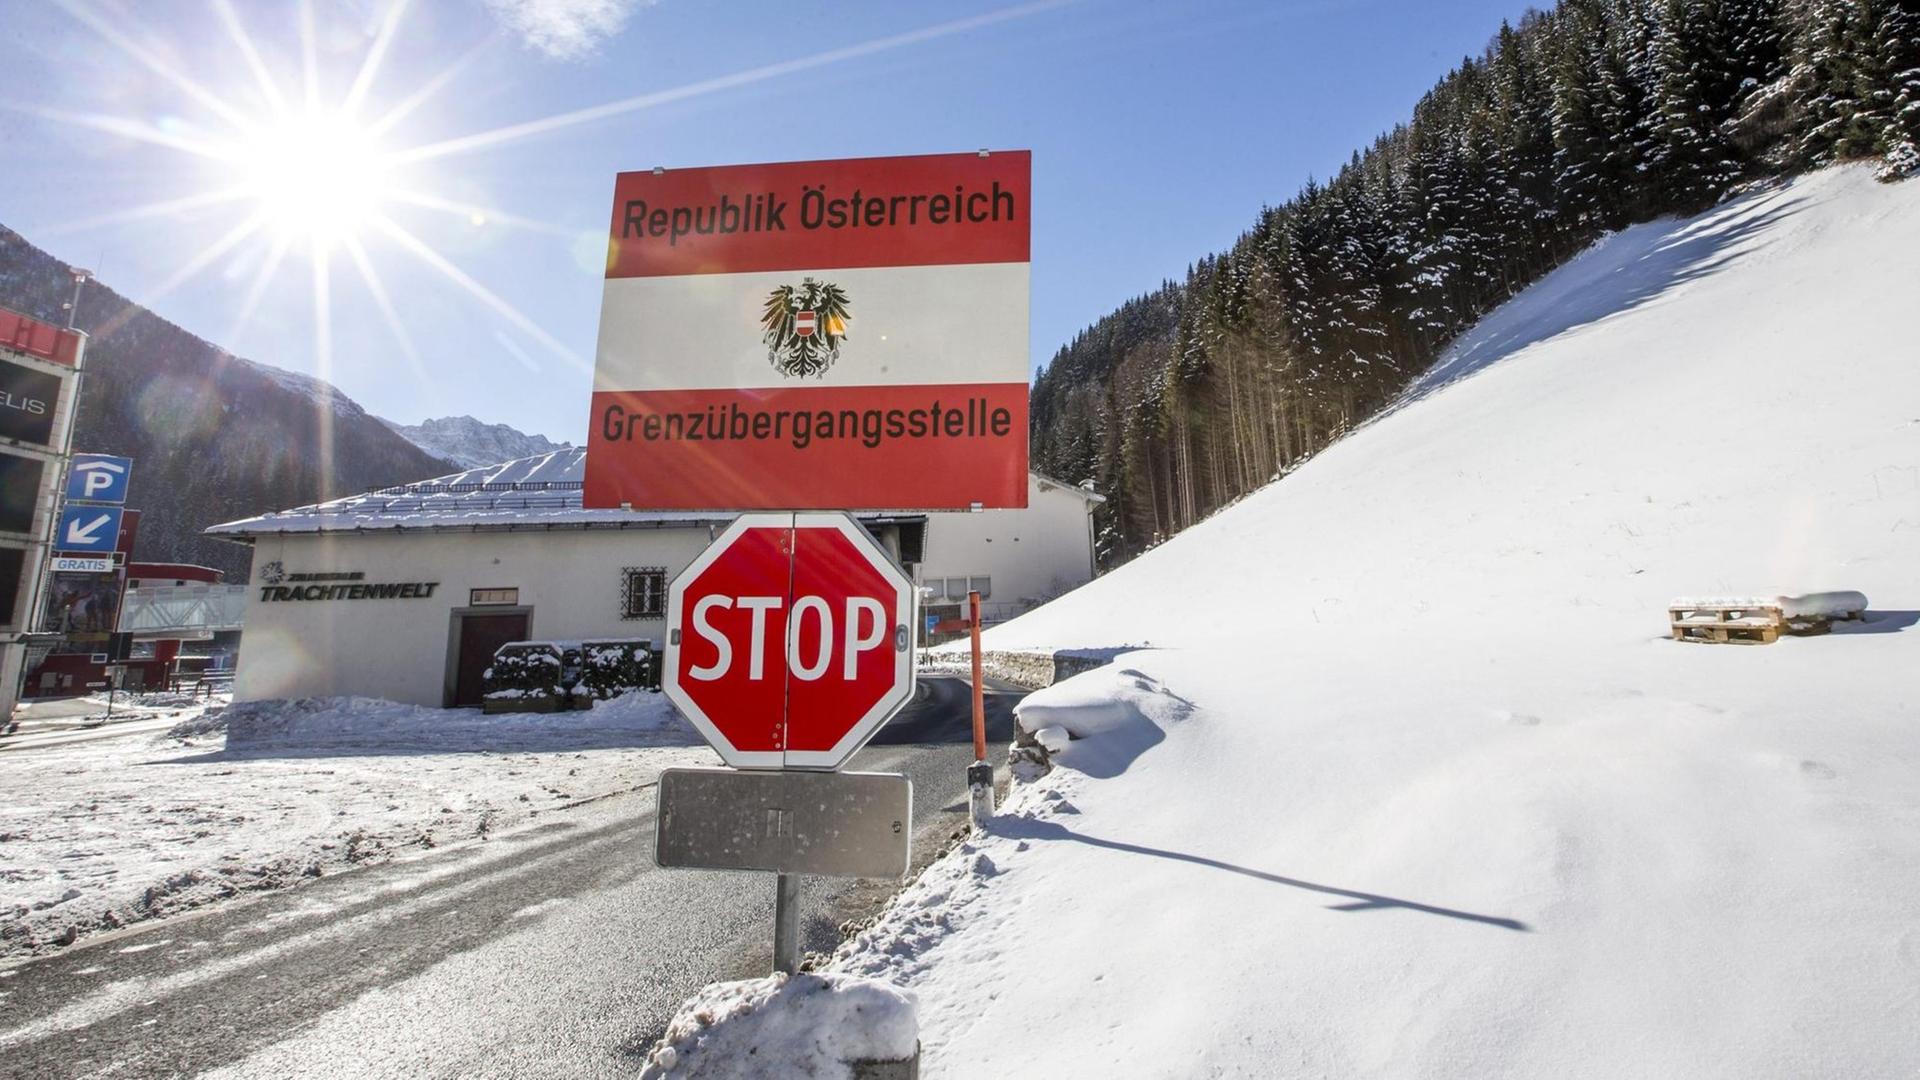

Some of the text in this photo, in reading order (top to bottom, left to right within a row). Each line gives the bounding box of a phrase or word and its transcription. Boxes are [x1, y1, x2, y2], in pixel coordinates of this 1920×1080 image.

[622, 182, 1014, 246] Republik Österreich
[603, 398, 1011, 448] Grenzübergangsstelle
[84, 471, 113, 496] P
[57, 559, 106, 570] GRATIS
[261, 582, 440, 602] TRACHTENWELT
[688, 594, 887, 681] STOP
